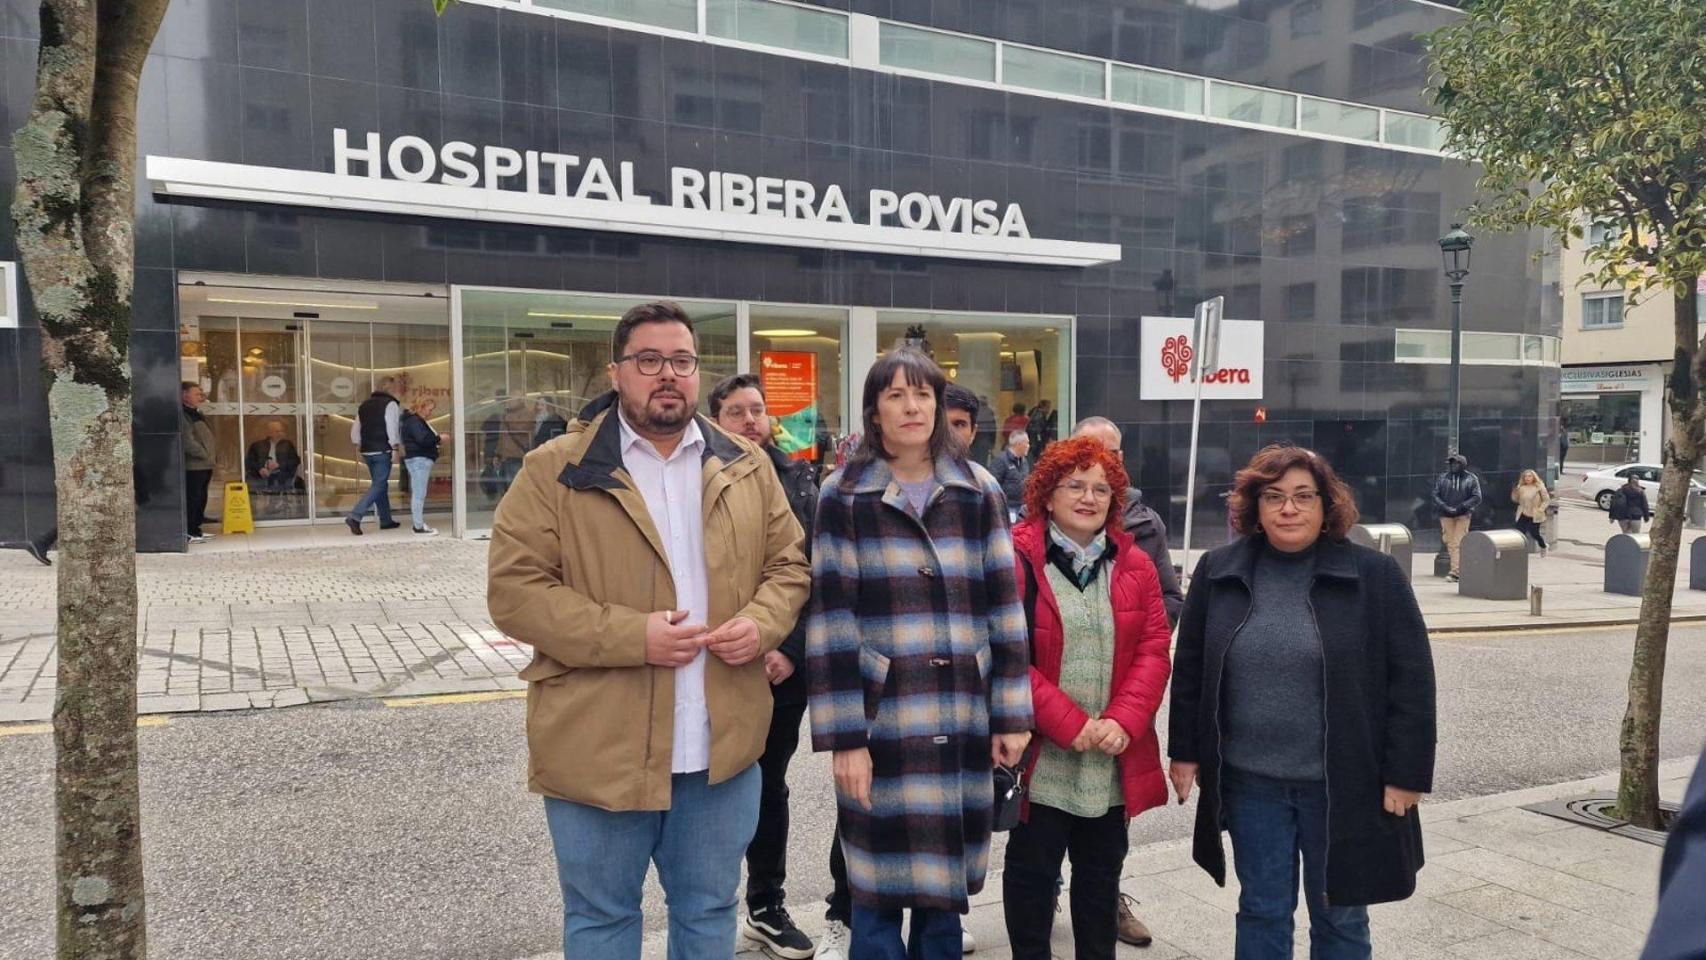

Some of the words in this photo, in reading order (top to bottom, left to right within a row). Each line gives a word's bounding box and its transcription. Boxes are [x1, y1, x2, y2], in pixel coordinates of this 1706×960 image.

[333, 128, 651, 204] HOSPITAL
[671, 166, 853, 225] RIBERA
[869, 189, 1031, 239] POVISA
[1191, 367, 1250, 383] bera
